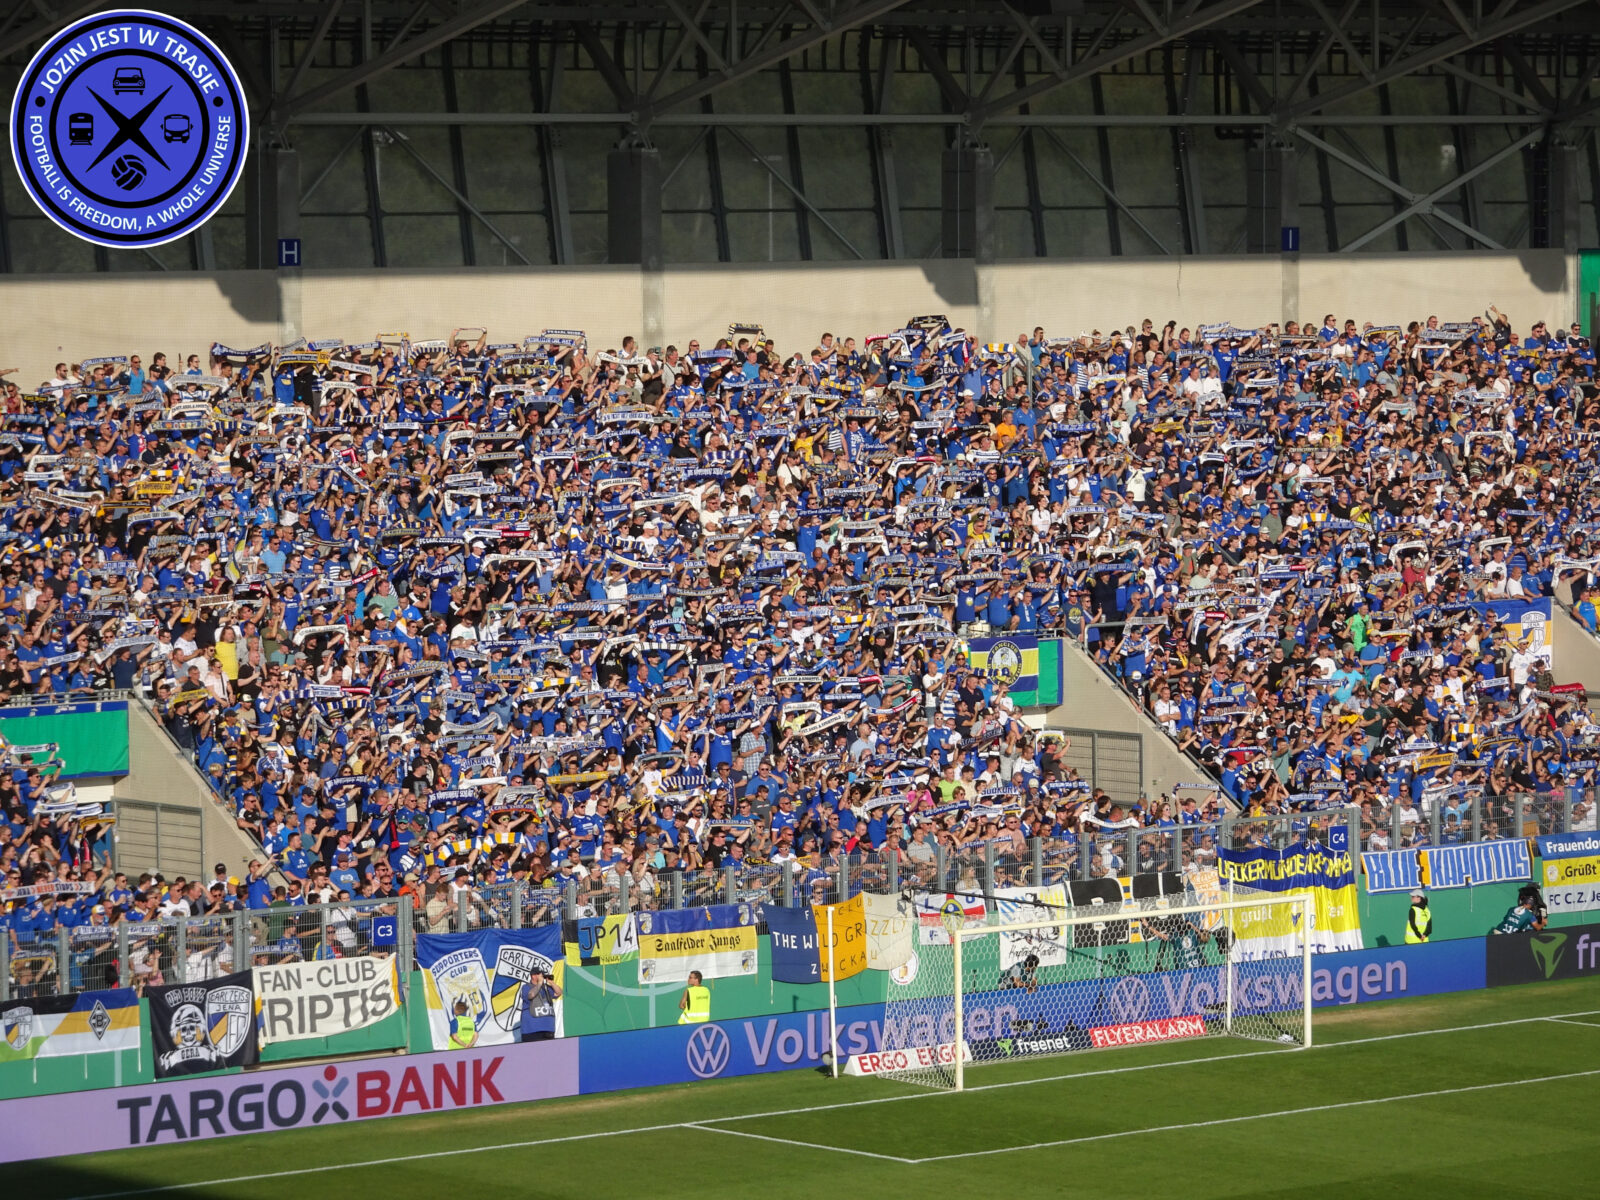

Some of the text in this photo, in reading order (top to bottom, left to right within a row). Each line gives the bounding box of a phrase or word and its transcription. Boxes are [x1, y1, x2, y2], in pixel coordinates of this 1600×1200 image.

[282, 241, 298, 264] H
[1332, 833, 1345, 844] C4
[1546, 837, 1600, 854] Frauendo
[1362, 849, 1422, 892] BLUE
[36, 883, 55, 895] NEVER
[1549, 893, 1561, 906] FC
[377, 924, 393, 937] C3
[655, 936, 706, 953] Saalfelder
[773, 931, 798, 949] THE
[431, 949, 480, 977] SUPPORTERS
[502, 950, 526, 970] CARL
[811, 950, 878, 975] ZWCKAU
[450, 965, 468, 979] CLUB
[209, 990, 250, 1002] CARL ZEISS
[215, 1004, 242, 1012] JENA
[1094, 1016, 1204, 1047] FLYERALARM
[181, 1046, 201, 1060] GERA
[1017, 1036, 1072, 1054] freenet
[858, 1051, 908, 1073] ERGO
[117, 1056, 505, 1145] TARGO BANK
